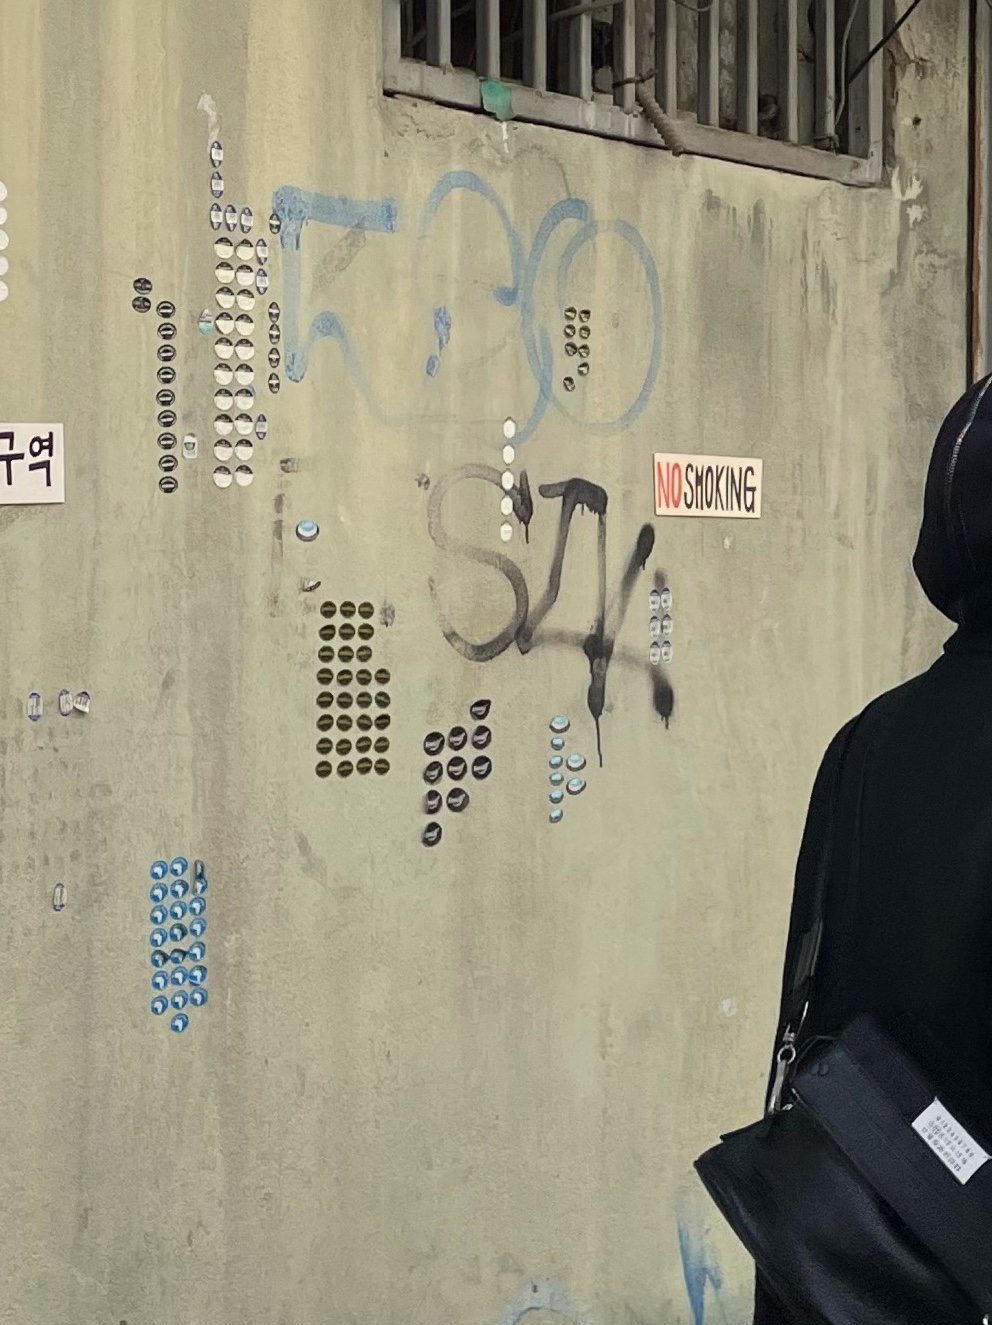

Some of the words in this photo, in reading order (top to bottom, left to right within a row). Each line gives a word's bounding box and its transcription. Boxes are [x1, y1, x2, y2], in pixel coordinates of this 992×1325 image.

[0, 431, 54, 487] 구역
[657, 461, 682, 509] NO
[683, 463, 757, 514] SMOKING
